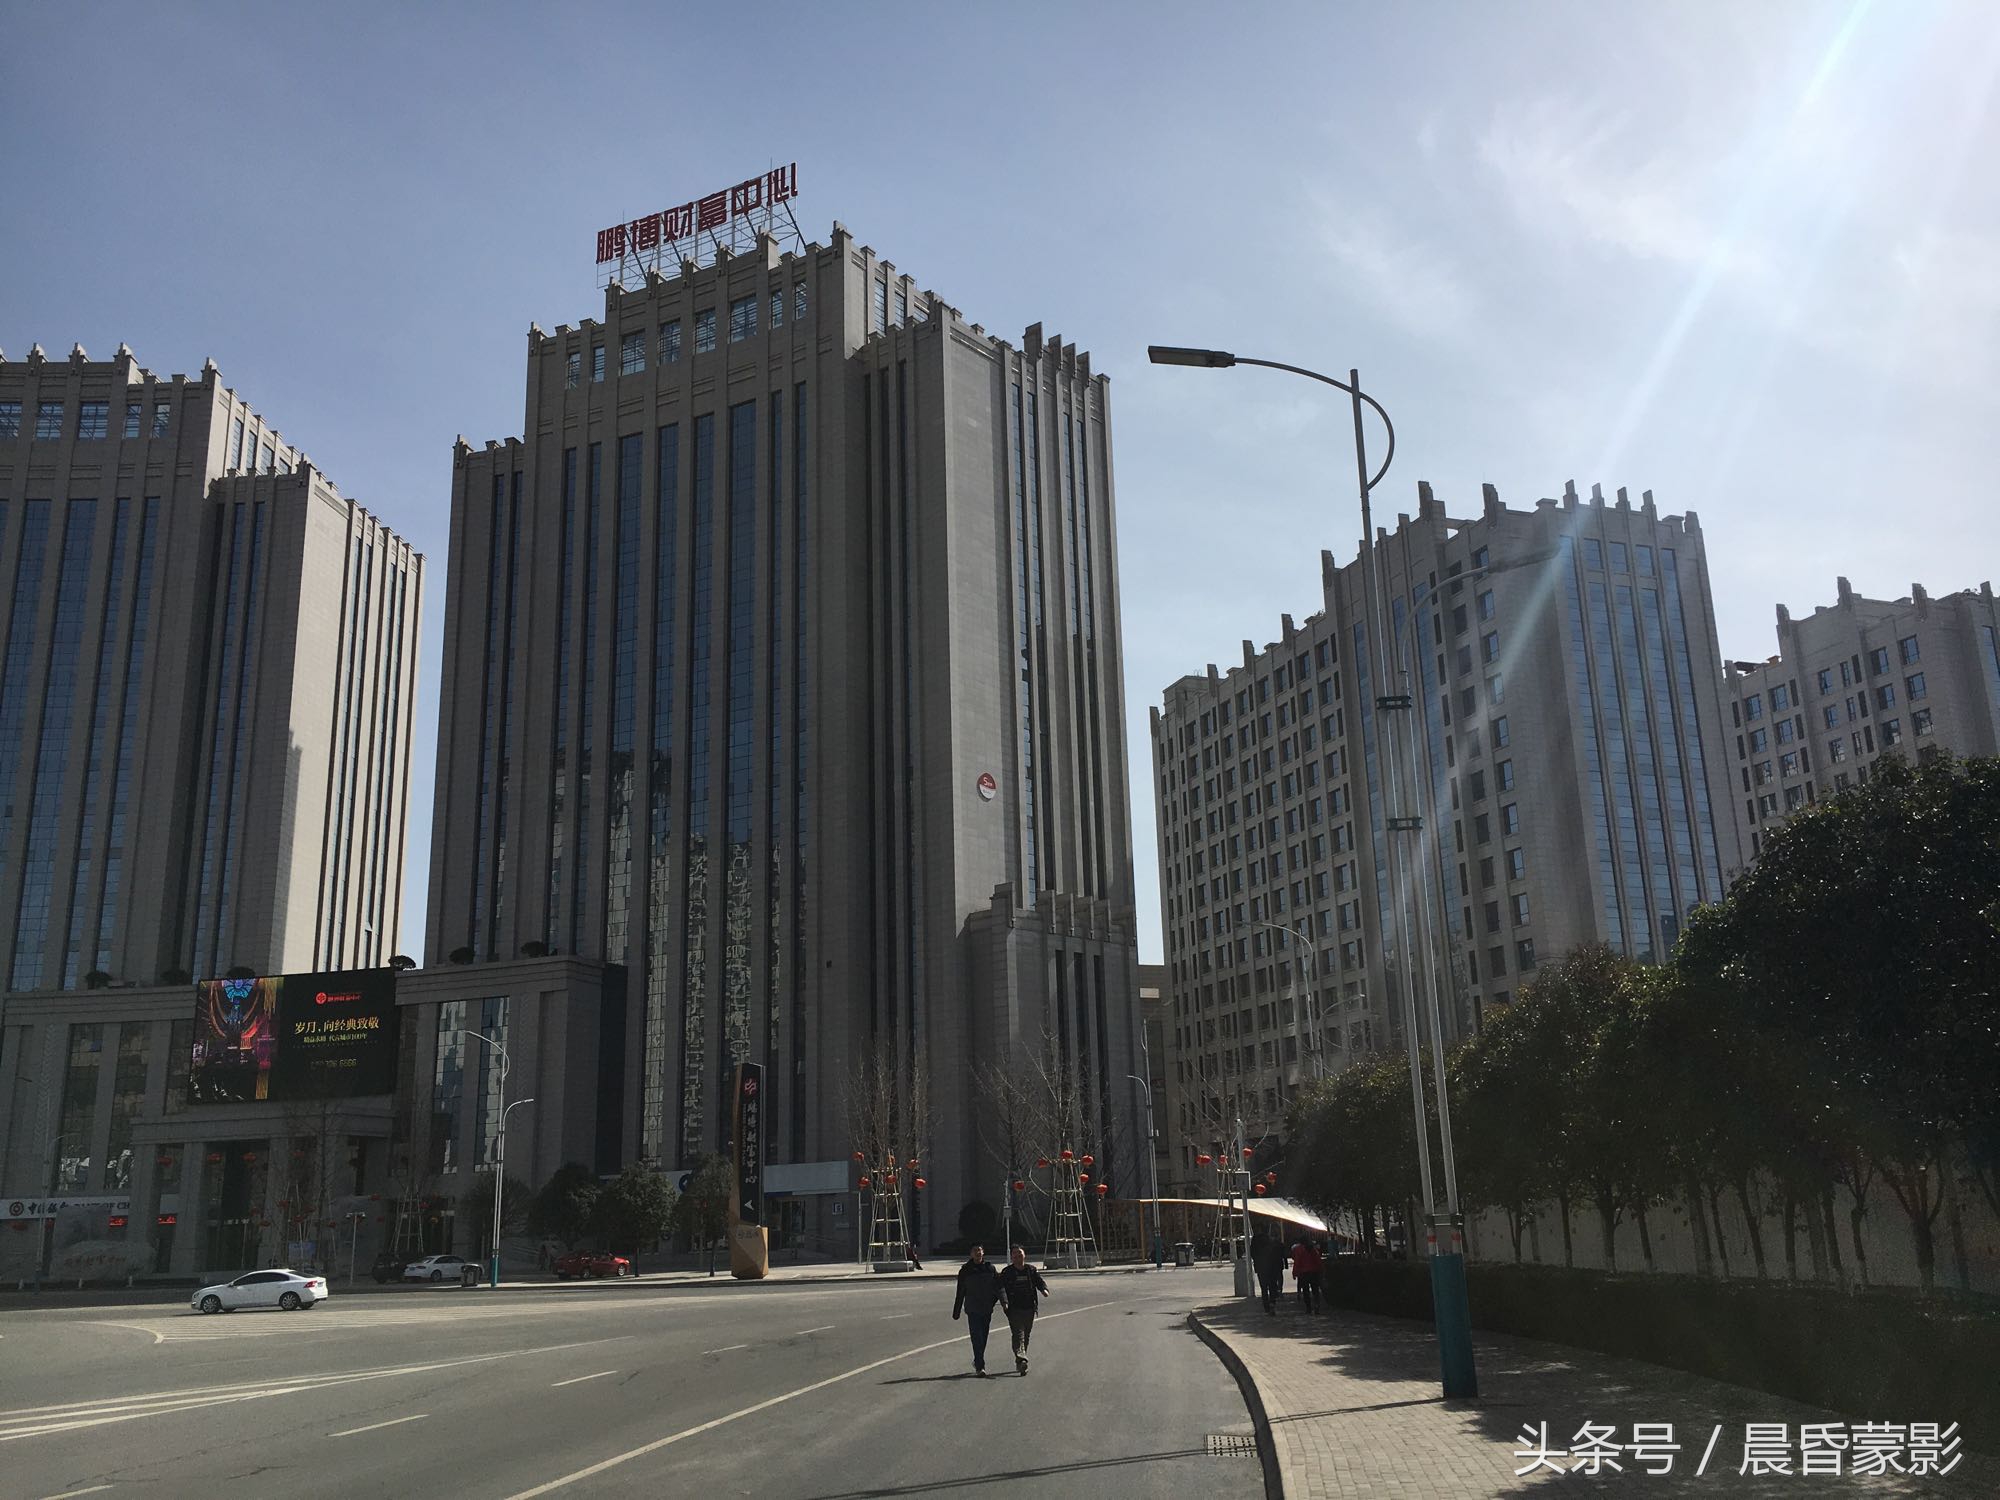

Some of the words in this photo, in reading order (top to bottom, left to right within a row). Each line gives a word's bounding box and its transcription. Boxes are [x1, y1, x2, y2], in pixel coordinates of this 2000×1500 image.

[596, 162, 798, 265] 鹏博财富中心
